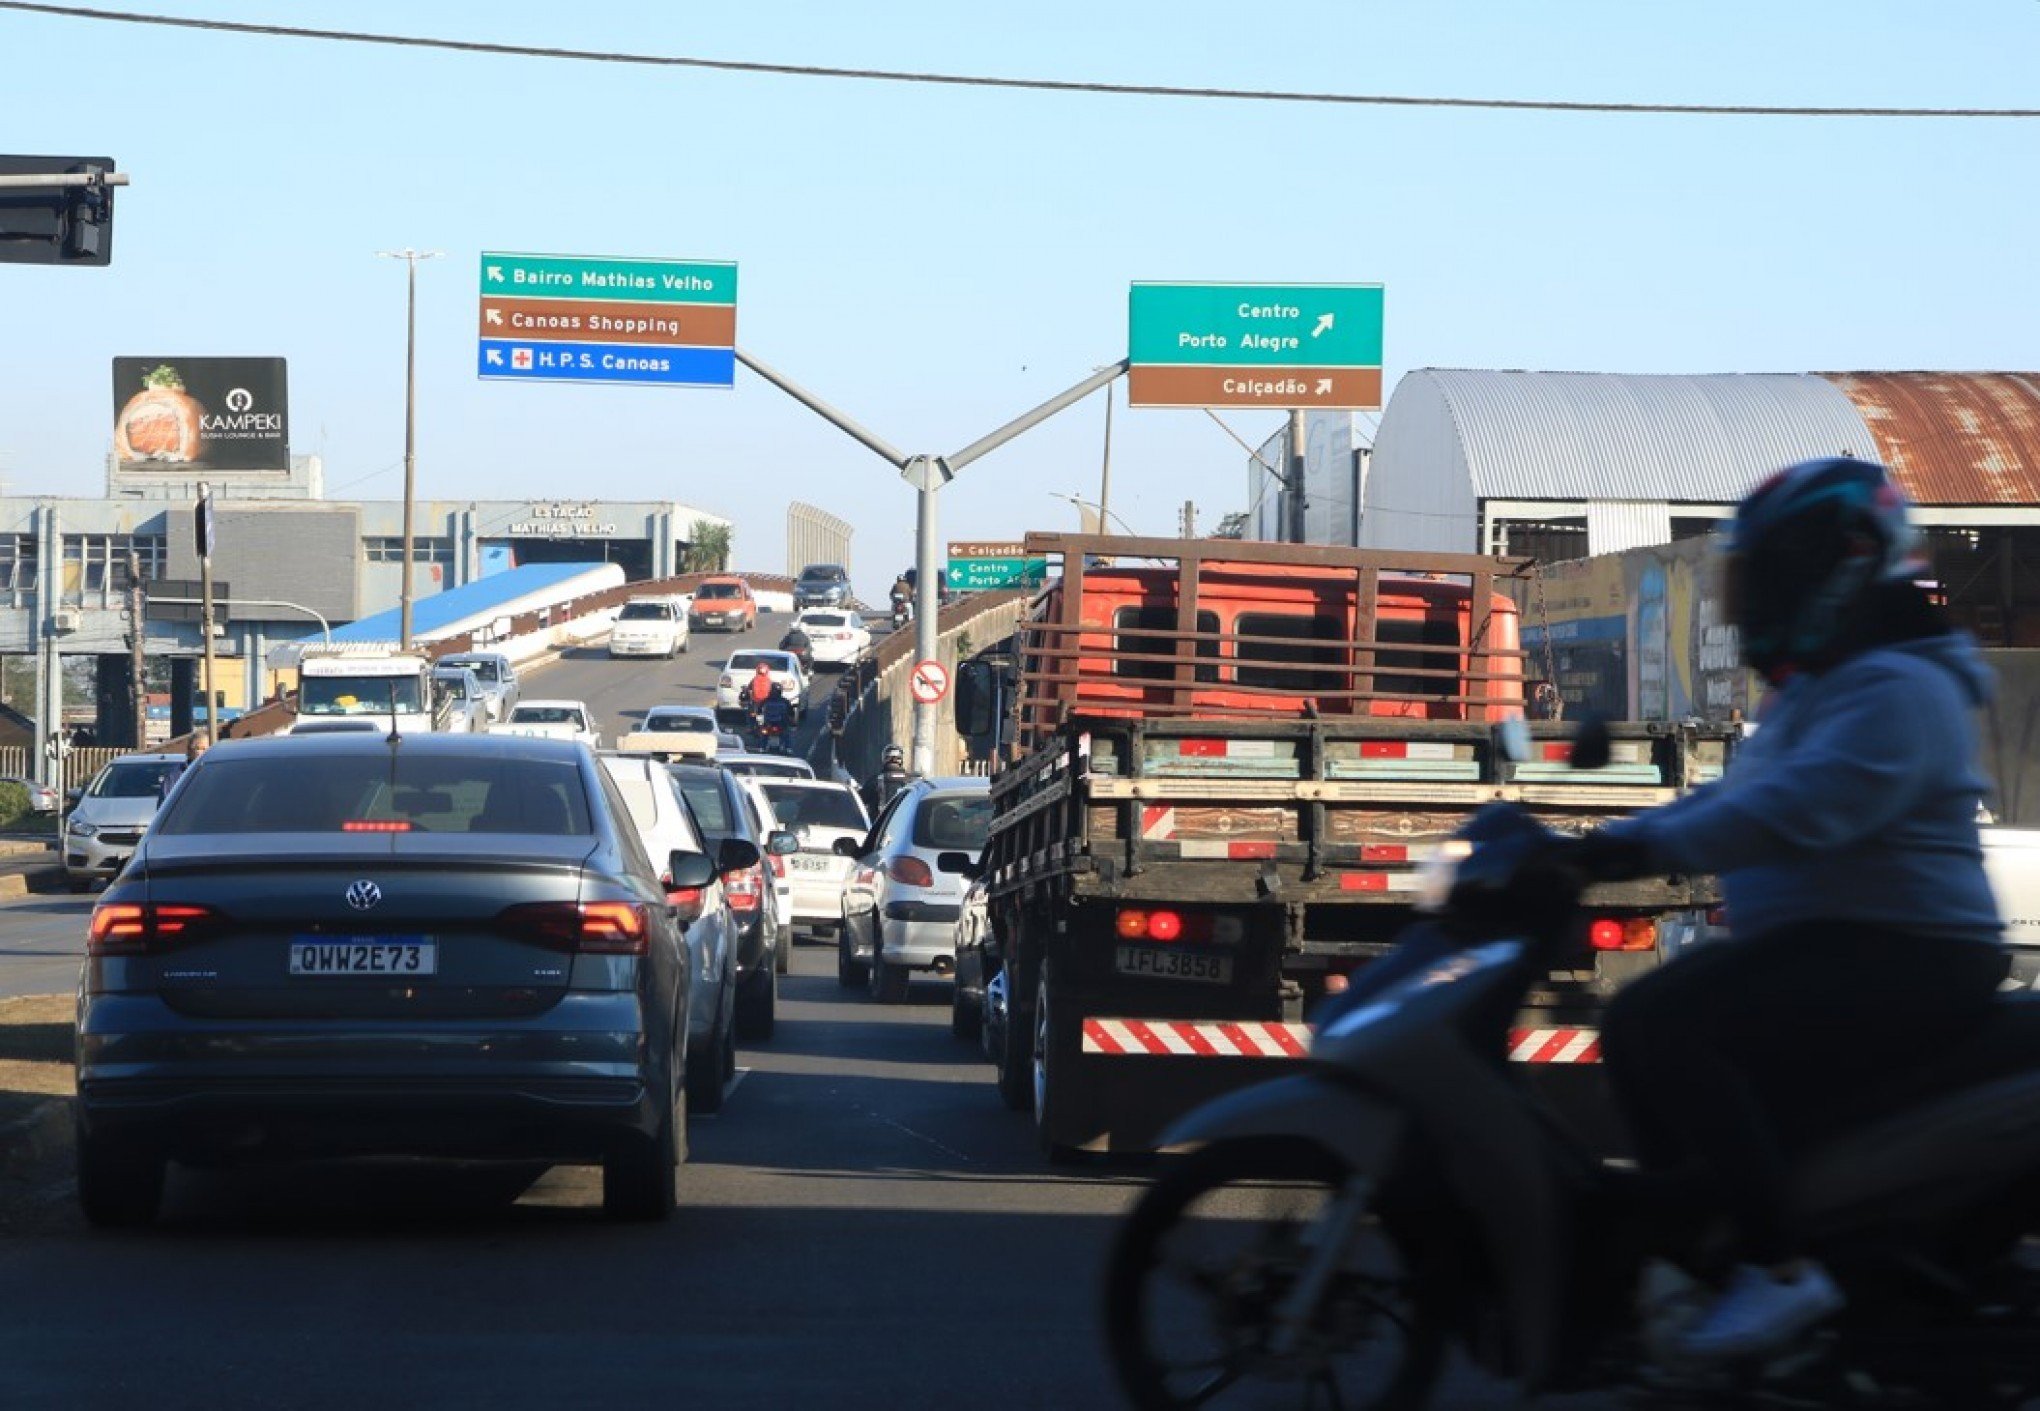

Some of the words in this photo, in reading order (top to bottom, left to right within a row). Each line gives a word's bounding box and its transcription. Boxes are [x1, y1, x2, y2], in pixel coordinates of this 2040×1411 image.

[513, 268, 573, 285] Bairro
[581, 271, 655, 288] Mathias
[662, 274, 714, 291] Velho
[1238, 303, 1300, 318] Centro
[511, 312, 581, 328] Canoas
[589, 315, 680, 336] Shopping
[1178, 332, 1227, 347] Porto
[1240, 333, 1299, 352] Alegre
[602, 354, 669, 371] Canoas
[1223, 378, 1306, 396] Calçadão
[199, 413, 281, 430] KAMPEKI
[509, 523, 567, 534] MATHIAS
[969, 564, 1008, 572] Centro
[969, 576, 1000, 585] Porto
